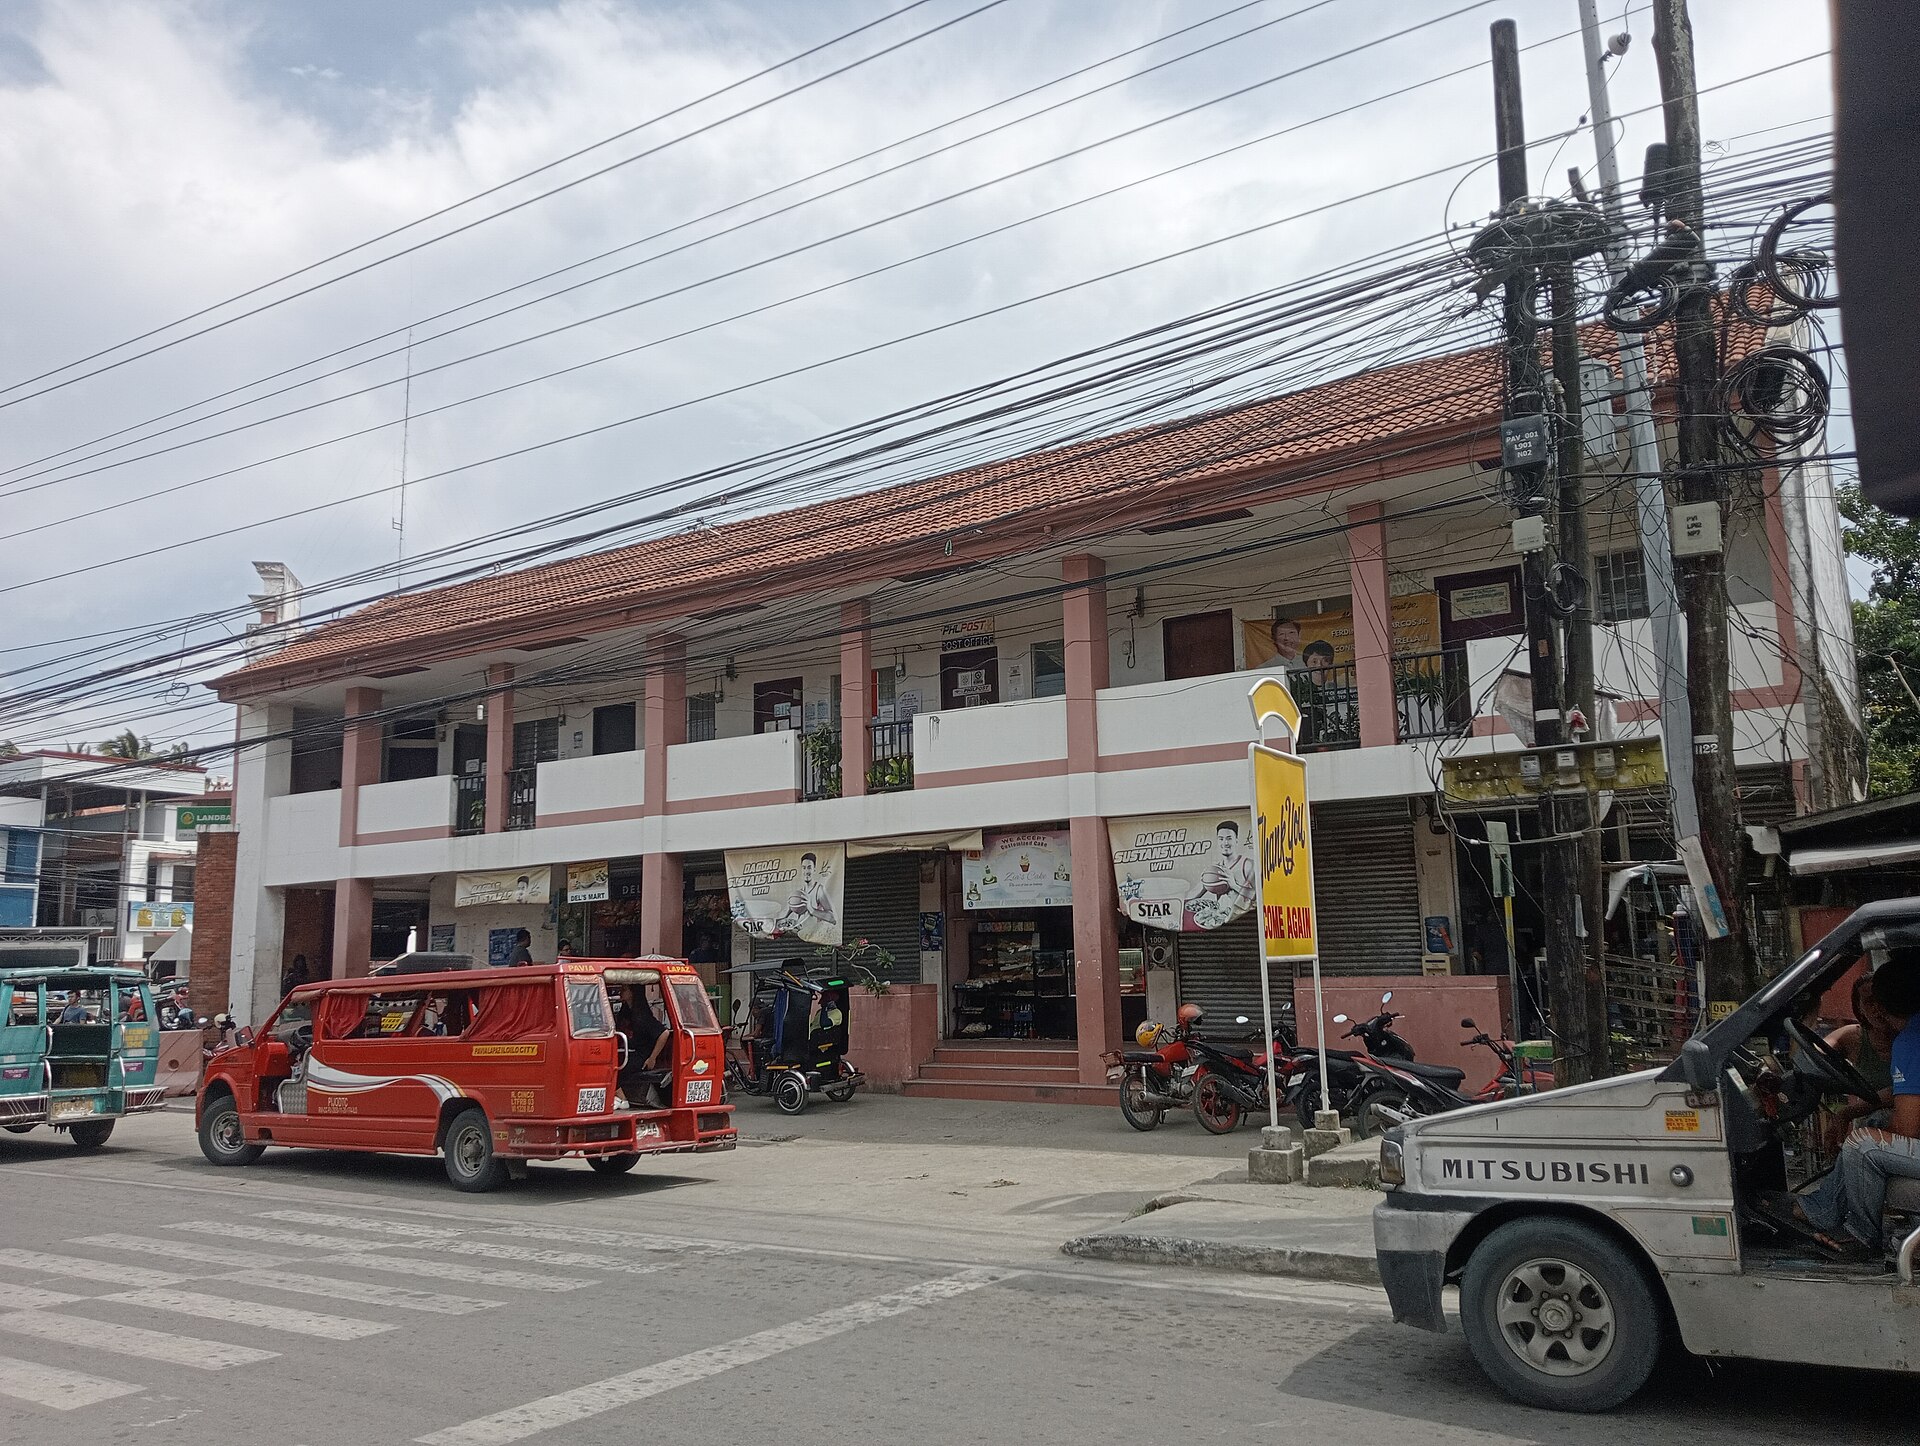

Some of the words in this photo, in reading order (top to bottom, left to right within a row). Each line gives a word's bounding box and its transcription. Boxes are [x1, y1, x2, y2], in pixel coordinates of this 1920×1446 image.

[1505, 431, 1539, 443] PAV_001
[1517, 450, 1532, 458] N02
[941, 620, 987, 635] PHLPOST
[942, 639, 963, 650] POST
[963, 635, 994, 648] OFFICE
[775, 704, 791, 715] BIR
[1695, 743, 1719, 755] 1122
[1135, 829, 1187, 847] DAGDAG
[1257, 803, 1287, 889] Thank
[1285, 796, 1306, 876] You
[1114, 840, 1212, 864] SUSTANSYARAP
[743, 859, 781, 875] DAGDAG
[1150, 860, 1174, 872] WITH
[728, 869, 797, 889] SUSTANSYARAP
[752, 886, 770, 896] WITH
[1138, 903, 1172, 917] STAR
[743, 921, 764, 933] STAR
[1263, 905, 1285, 939] COME
[1287, 906, 1312, 939] AGAIN
[568, 964, 595, 972] PAVIA
[667, 965, 691, 973] LAPAZ
[1713, 1004, 1733, 1013] 001
[1442, 1158, 1650, 1185] MITSUBISHI
